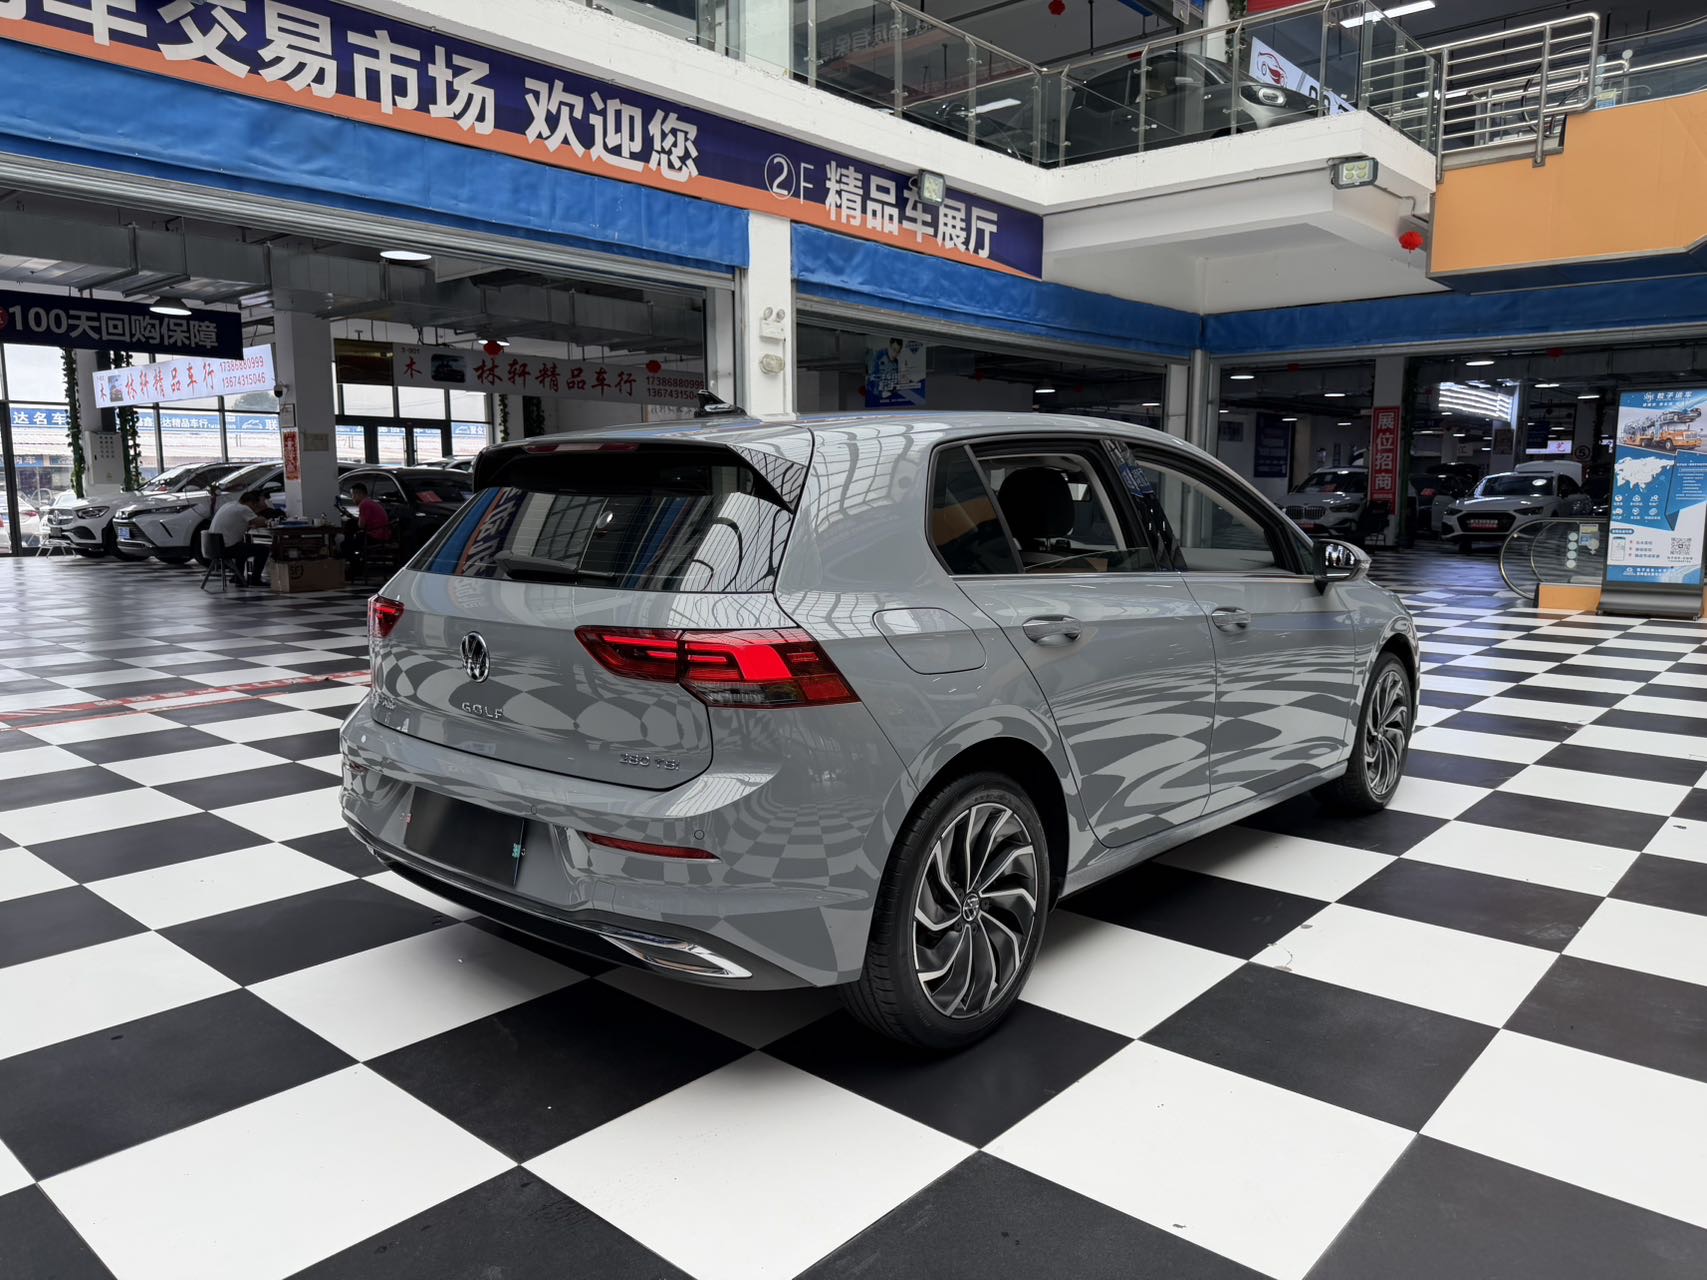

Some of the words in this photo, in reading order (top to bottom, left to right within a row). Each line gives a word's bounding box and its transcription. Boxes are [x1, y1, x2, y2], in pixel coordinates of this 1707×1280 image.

[0, 0, 497, 135] 车交易市场
[524, 75, 699, 183] 欢迎您
[825, 160, 998, 259] 精品车展厅
[8, 305, 218, 349] 100天回购保障
[125, 362, 216, 399] 林轩精品车行
[222, 372, 266, 388] 13674315046
[404, 356, 422, 378] 木
[473, 358, 637, 397] 林轩精品车行
[647, 388, 697, 400] 136743150
[13, 411, 68, 426] 达名车
[1375, 412, 1394, 490] 展位招商
[461, 702, 504, 720] GOLF
[653, 758, 680, 771] TSI
